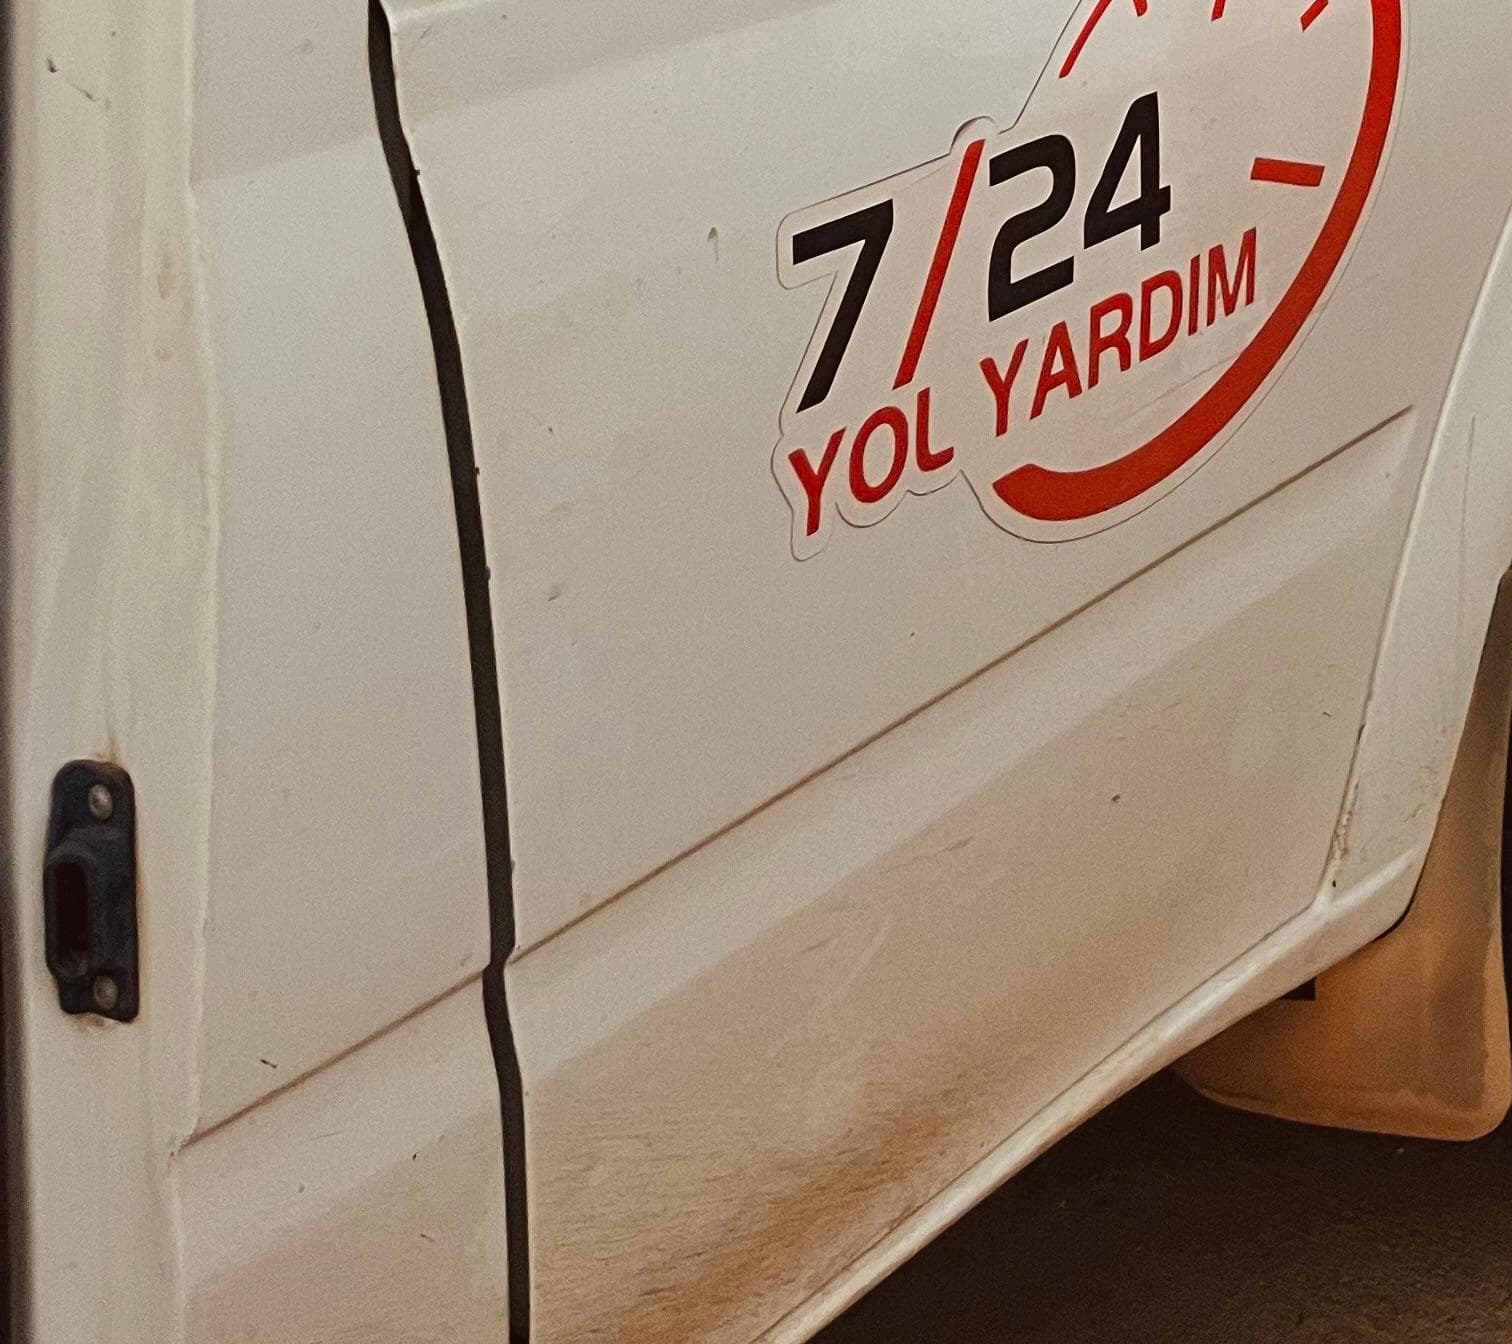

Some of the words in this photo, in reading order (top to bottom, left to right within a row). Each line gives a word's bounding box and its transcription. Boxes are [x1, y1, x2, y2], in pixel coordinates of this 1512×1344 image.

[787, 386, 955, 537] YOL
[978, 225, 1259, 438] YARDIM
[791, 90, 1173, 414] 7/24
